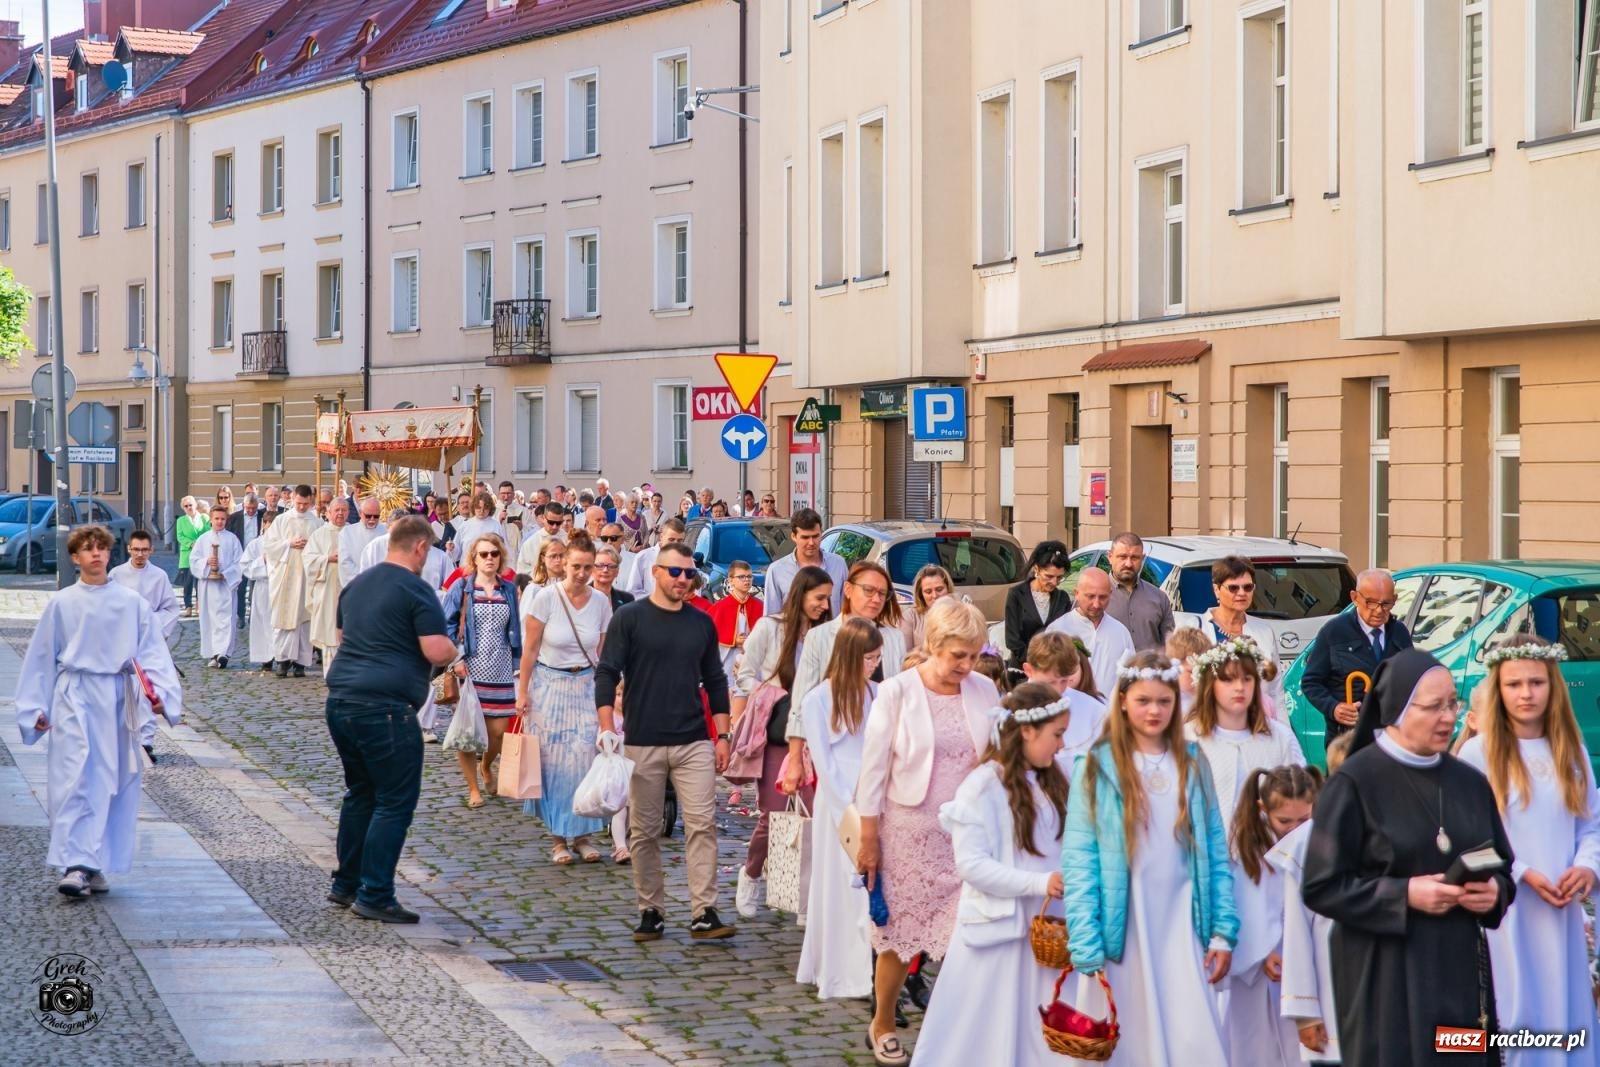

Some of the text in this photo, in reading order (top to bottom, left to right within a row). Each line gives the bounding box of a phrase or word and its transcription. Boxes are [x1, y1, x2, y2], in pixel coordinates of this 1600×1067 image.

[925, 393, 955, 434] P
[800, 421, 824, 430] ABC
[924, 447, 953, 456] Koniec
[795, 461, 808, 474] OKNA
